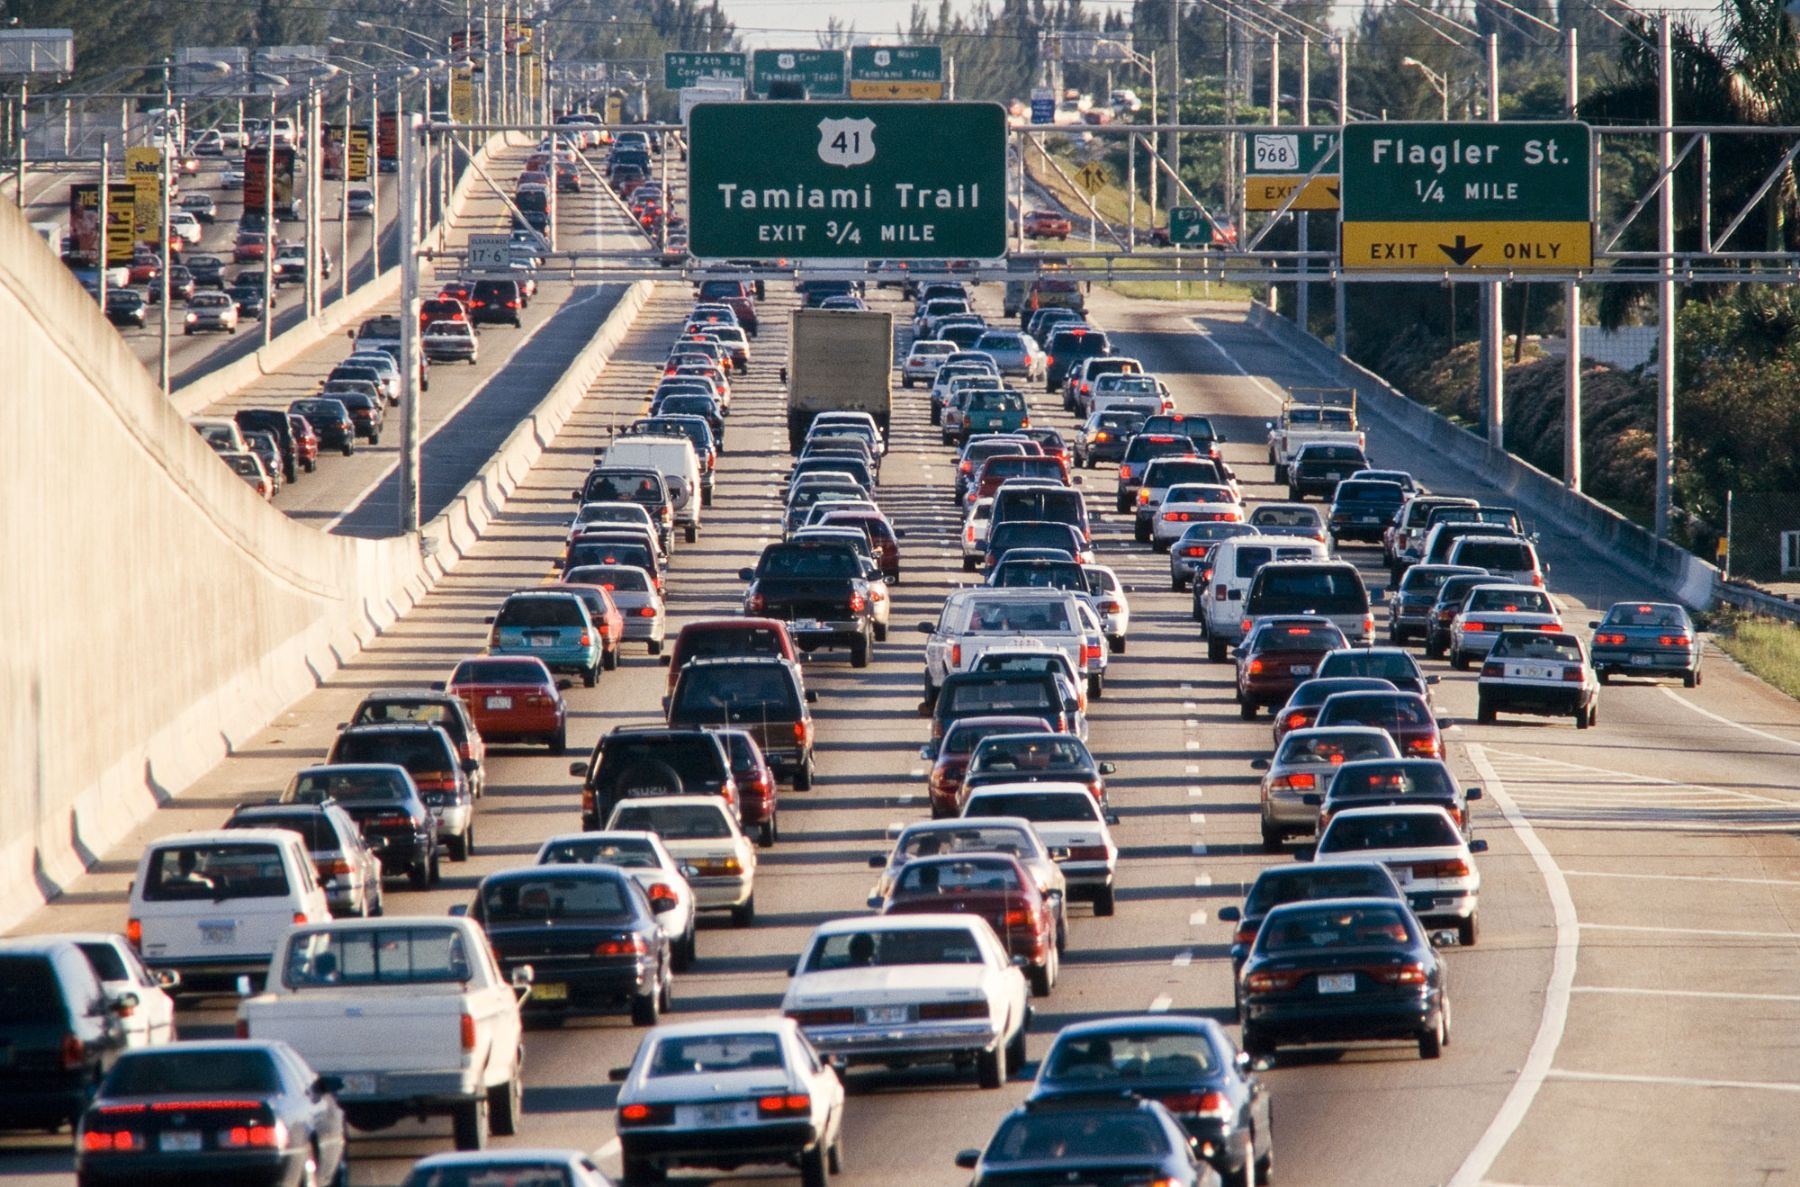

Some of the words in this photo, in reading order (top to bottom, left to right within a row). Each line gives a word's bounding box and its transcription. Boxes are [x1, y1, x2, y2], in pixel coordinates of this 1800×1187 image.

[670, 57, 687, 65] SW
[694, 57, 721, 65] 24th
[729, 57, 741, 65] St
[677, 68, 704, 76] Coral
[761, 72, 805, 81] Tamiami
[813, 73, 837, 81] Trail
[859, 69, 903, 78] Tamiami
[911, 69, 936, 78] Trail
[830, 131, 860, 154] 41
[1257, 147, 1288, 162] 968
[1373, 139, 1499, 174] Flagler
[1524, 139, 1569, 165] St.
[718, 183, 872, 208] Tamiami
[895, 182, 979, 208] Trail
[1415, 179, 1445, 203] 1/4
[1465, 183, 1519, 200] MILE
[106, 190, 134, 260] LIPTON
[759, 225, 807, 242] EXIT
[826, 221, 861, 245] 3/4
[881, 225, 935, 242] MILE
[1371, 244, 1418, 259] EXIT
[1504, 243, 1561, 259] ONLY
